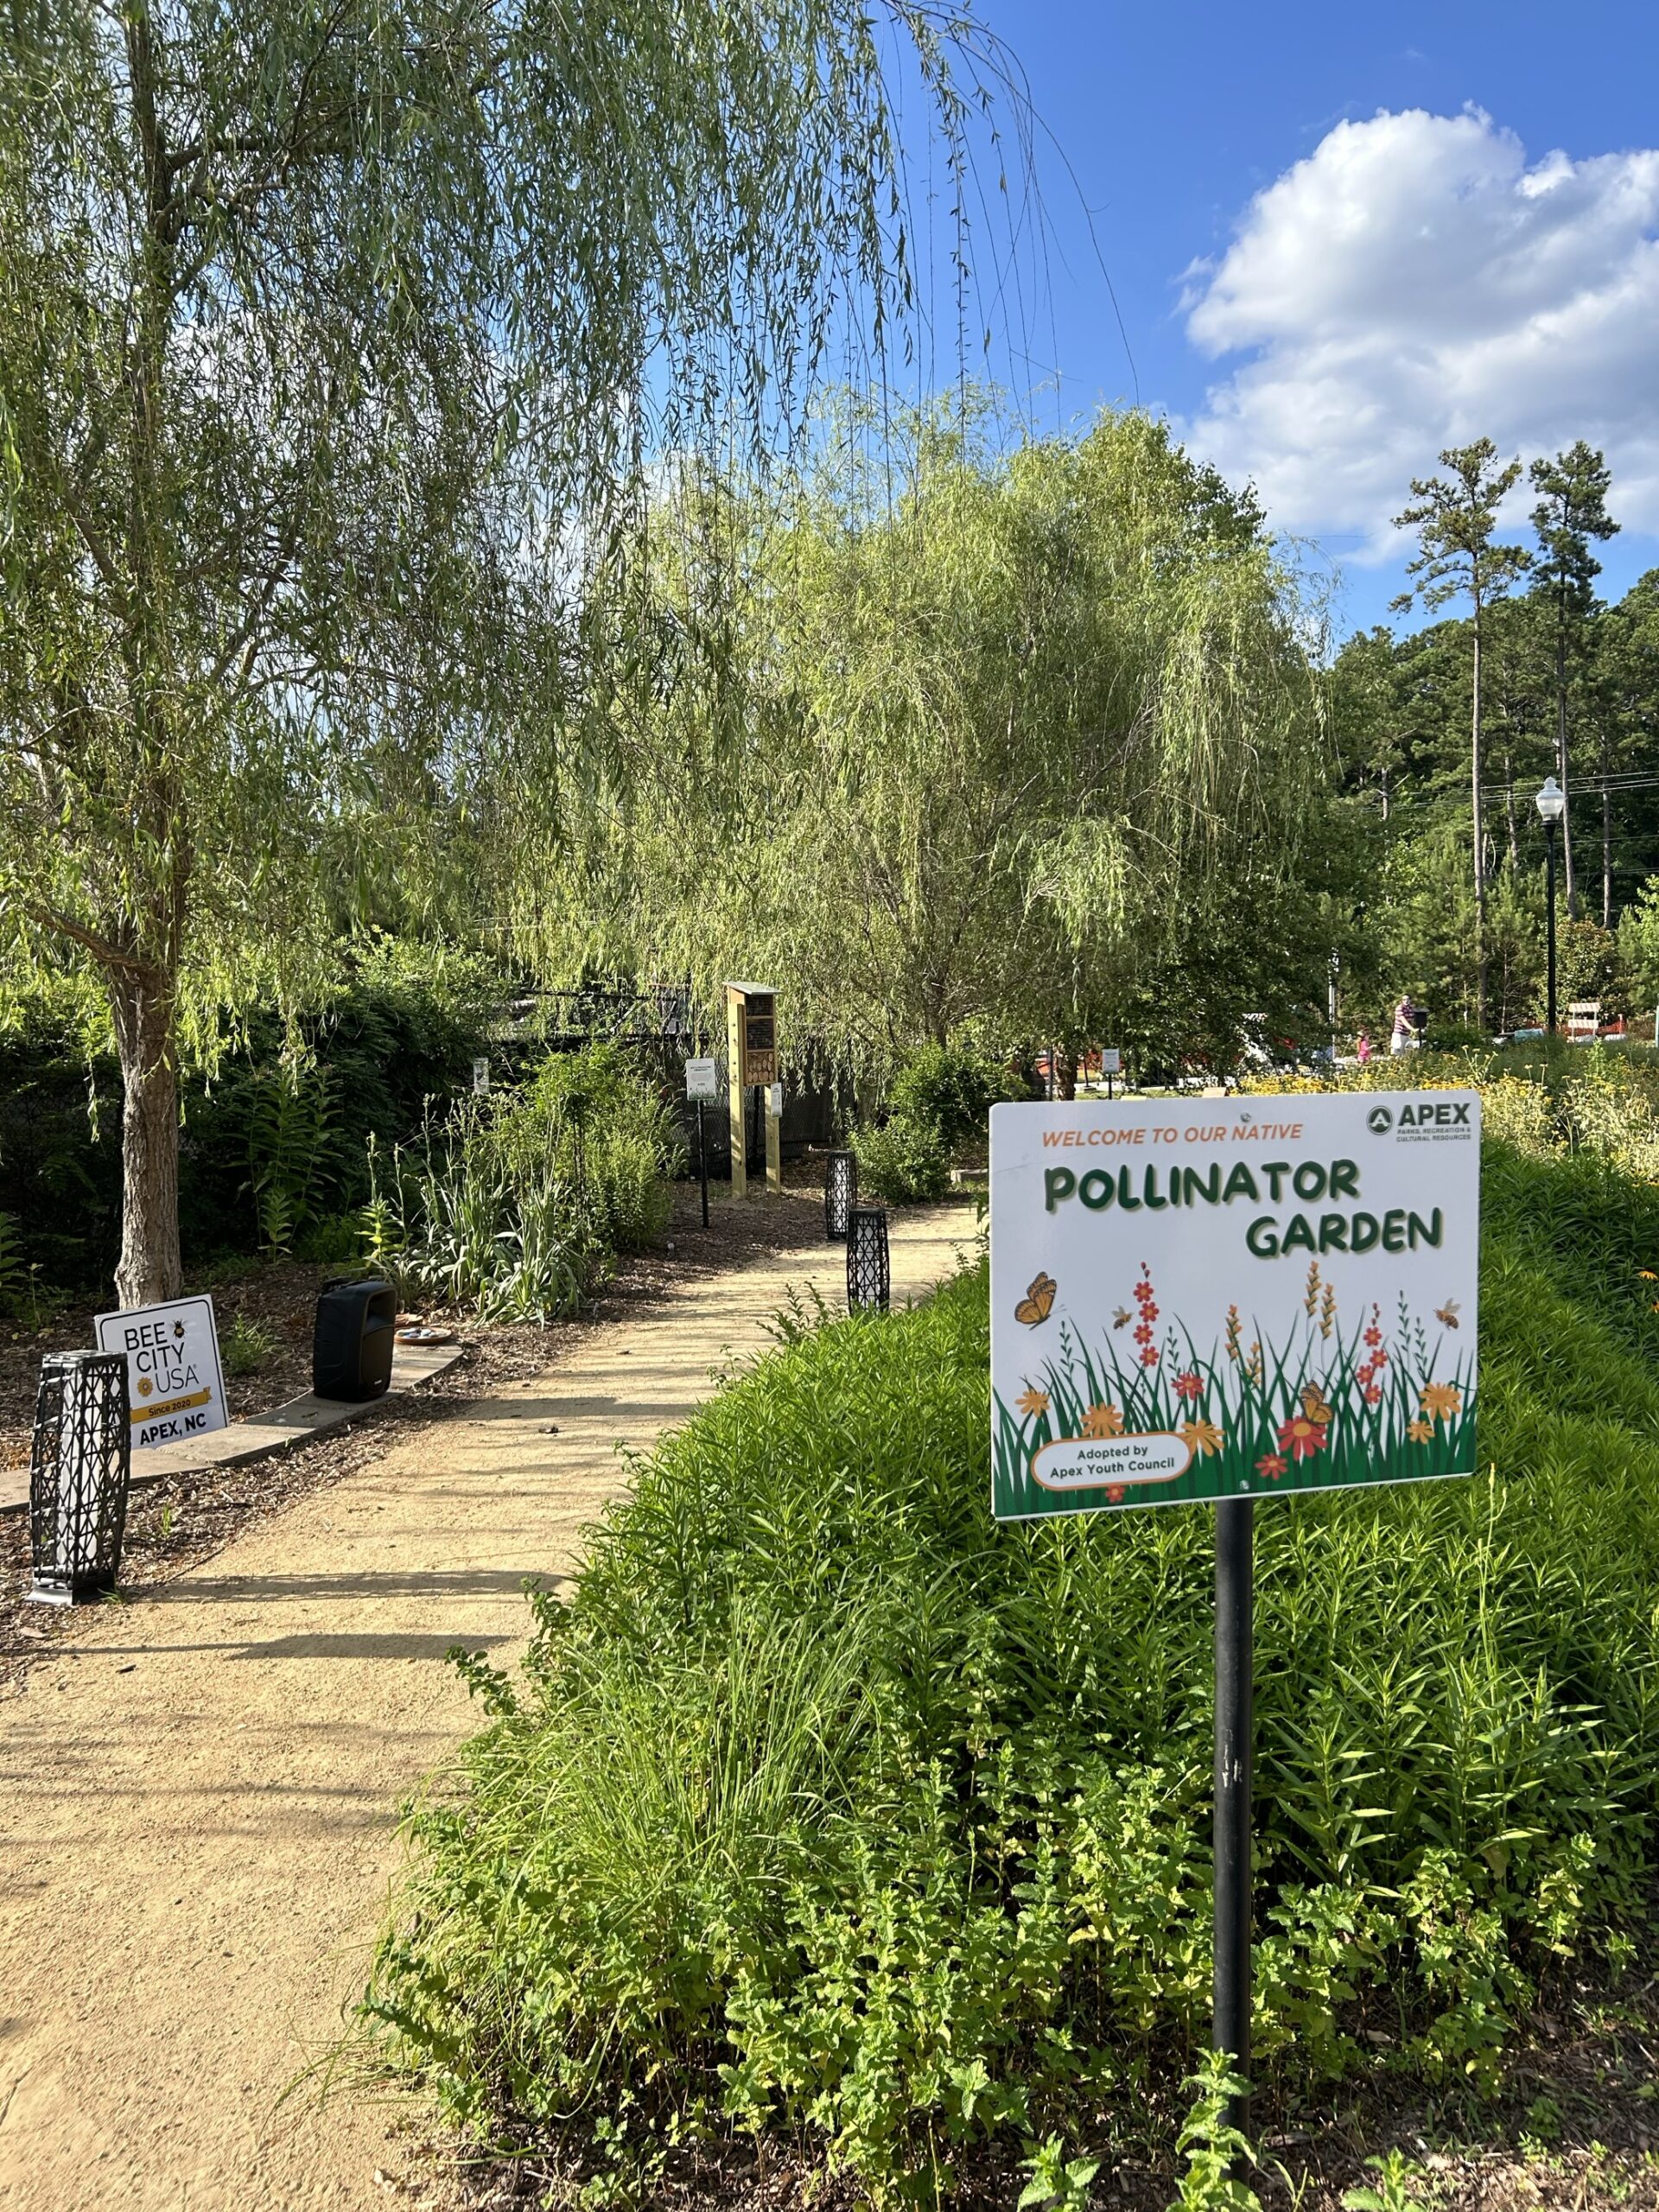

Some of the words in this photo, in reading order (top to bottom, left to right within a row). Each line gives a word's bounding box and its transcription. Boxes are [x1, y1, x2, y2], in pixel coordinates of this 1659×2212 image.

[1398, 1103, 1471, 1126] APEX
[1042, 1128, 1146, 1147] WELCOME
[1152, 1128, 1178, 1144] TO
[1184, 1126, 1227, 1142] OUR
[1231, 1123, 1303, 1141] NATIVE
[1043, 1159, 1360, 1214] POLLINATOR
[1245, 1207, 1442, 1259] GARDEN
[124, 1322, 168, 1351] BEE
[137, 1342, 185, 1373] CITY
[148, 1404, 170, 1417] Since
[172, 1399, 191, 1412] 2020
[140, 1420, 183, 1446] APEX,
[185, 1413, 207, 1432] NC
[1077, 1446, 1129, 1461] Adopted
[1133, 1445, 1148, 1457] by
[1050, 1467, 1083, 1479] Apex
[1086, 1462, 1124, 1475] Youth
[1128, 1457, 1175, 1471] Council
